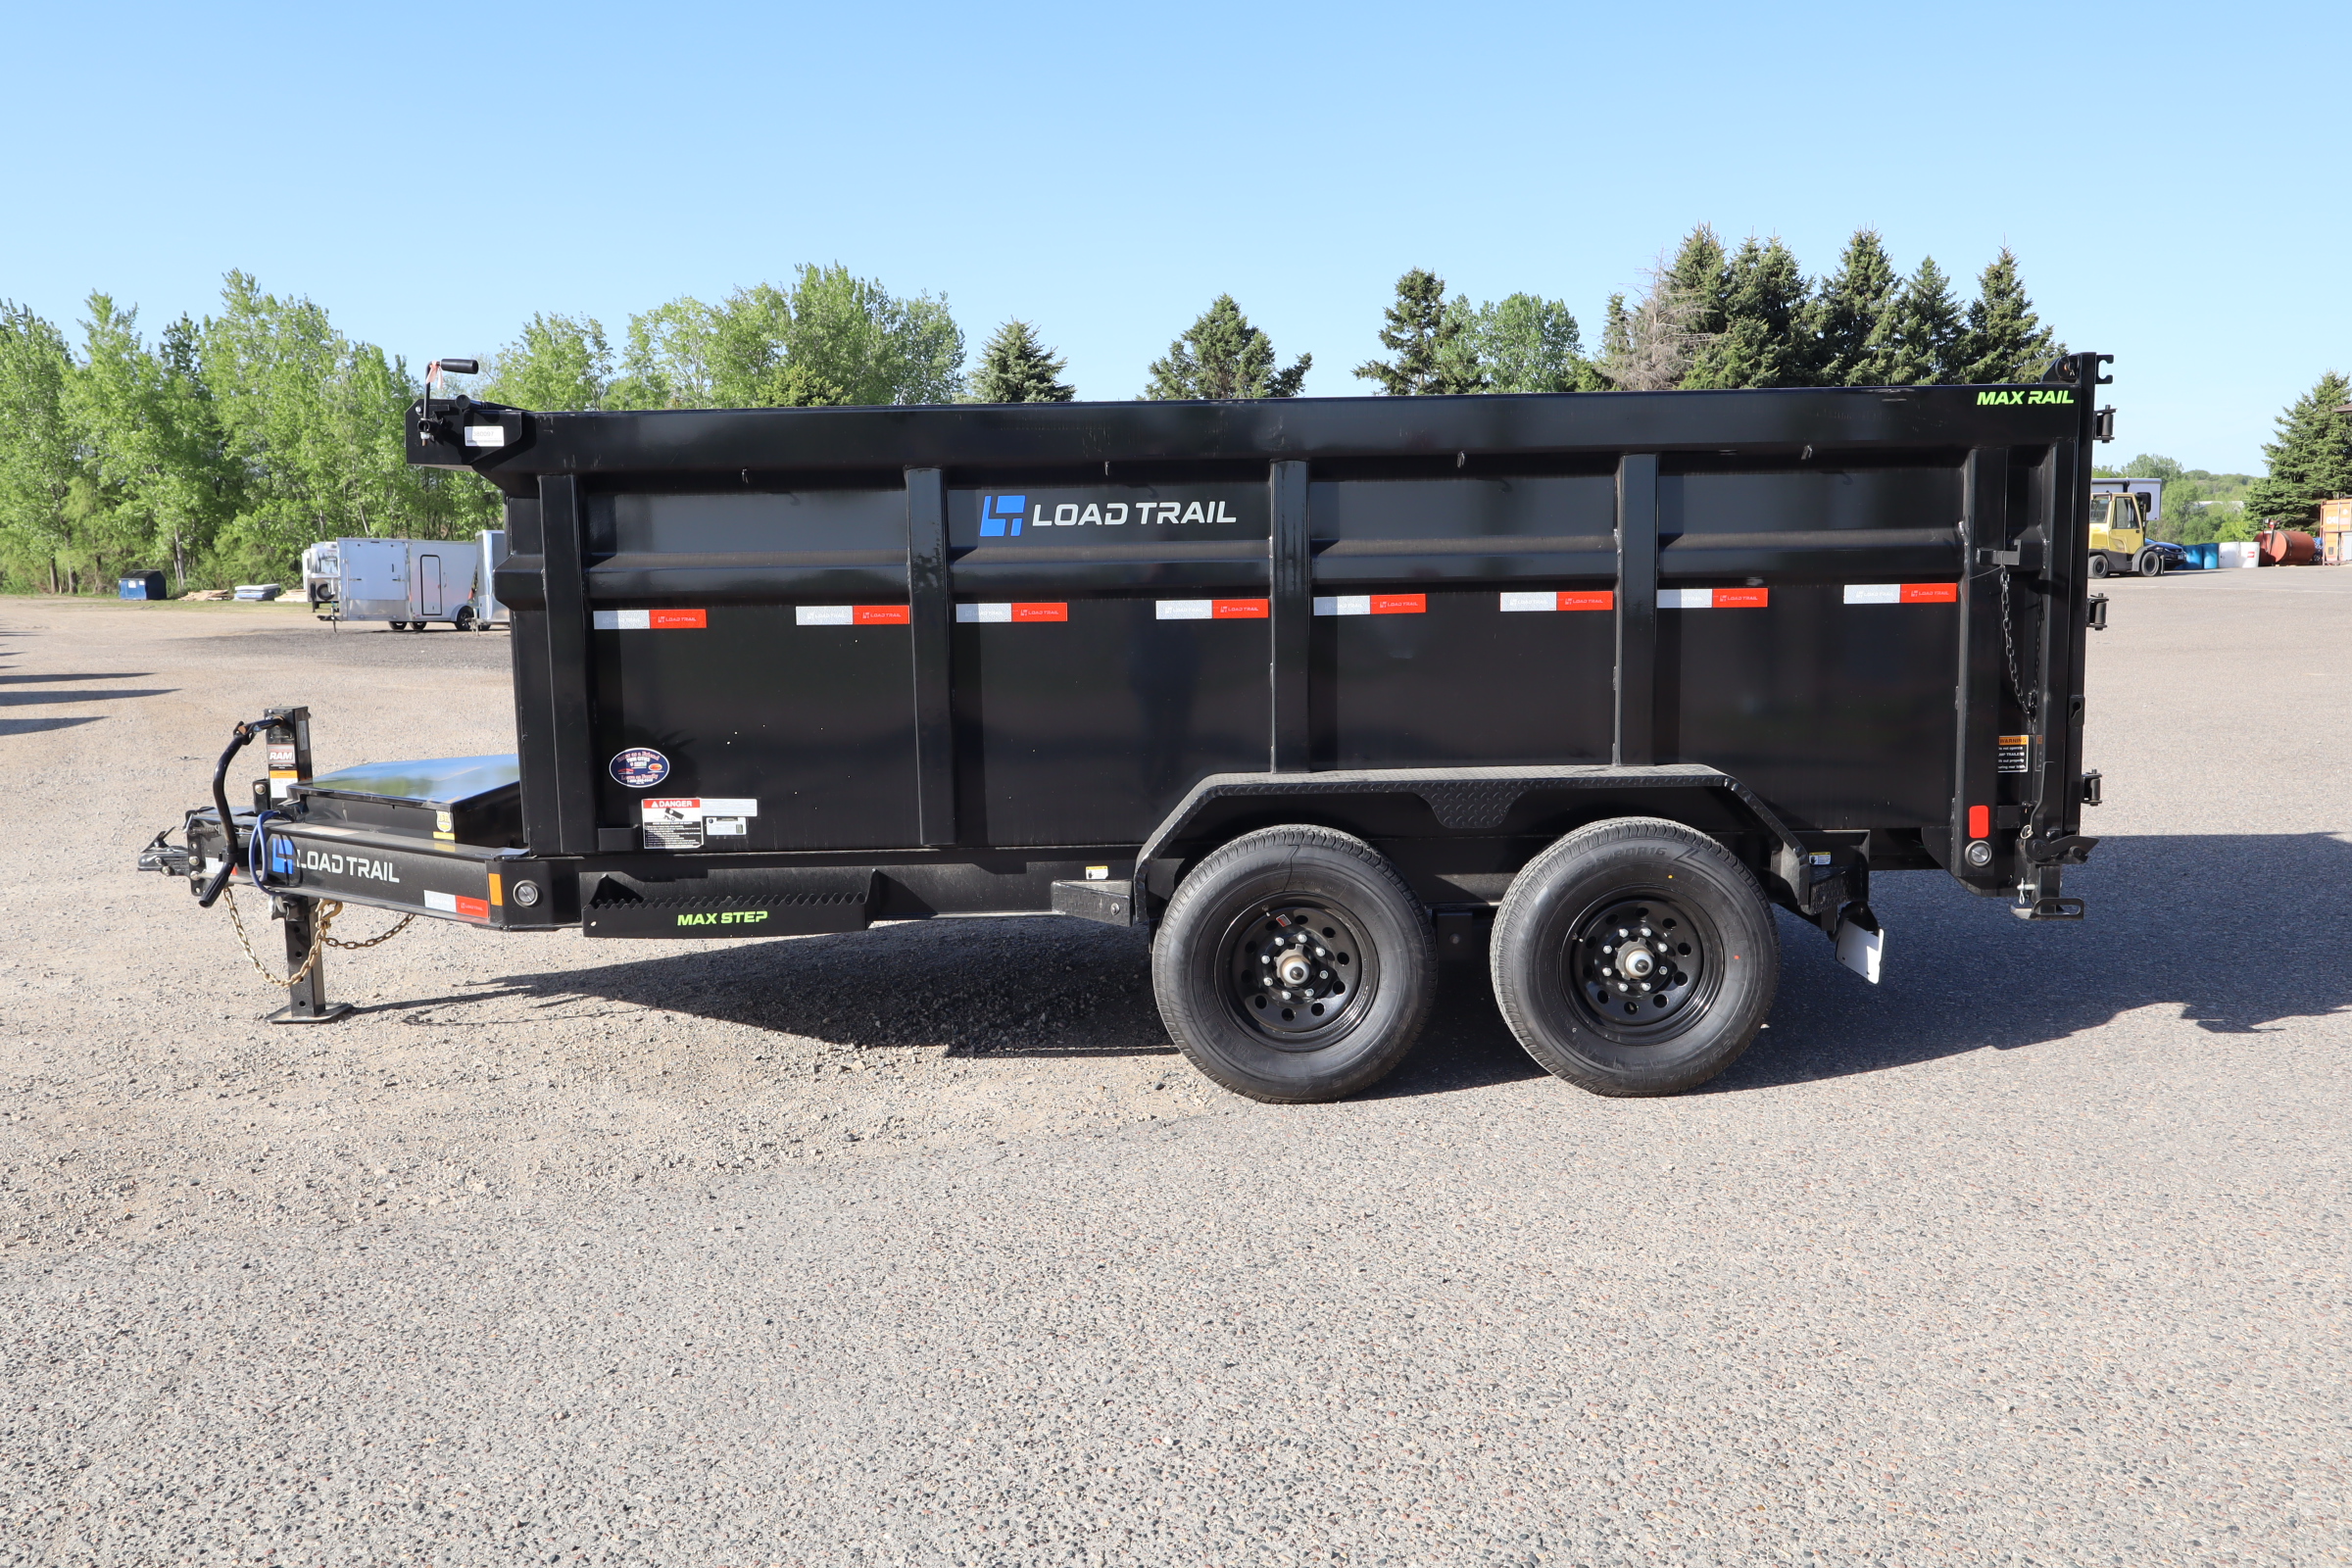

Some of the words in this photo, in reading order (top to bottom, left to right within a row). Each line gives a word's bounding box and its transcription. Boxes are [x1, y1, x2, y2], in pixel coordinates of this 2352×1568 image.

[1977, 390, 2025, 405] MAX
[2028, 389, 2075, 405] RAIL
[1032, 503, 1129, 526] LOAD
[1136, 501, 1237, 525] TRAIL
[297, 849, 344, 874] LOAD
[346, 857, 400, 883] TRAIL
[677, 912, 718, 926] MAX
[720, 910, 768, 924] STEP
